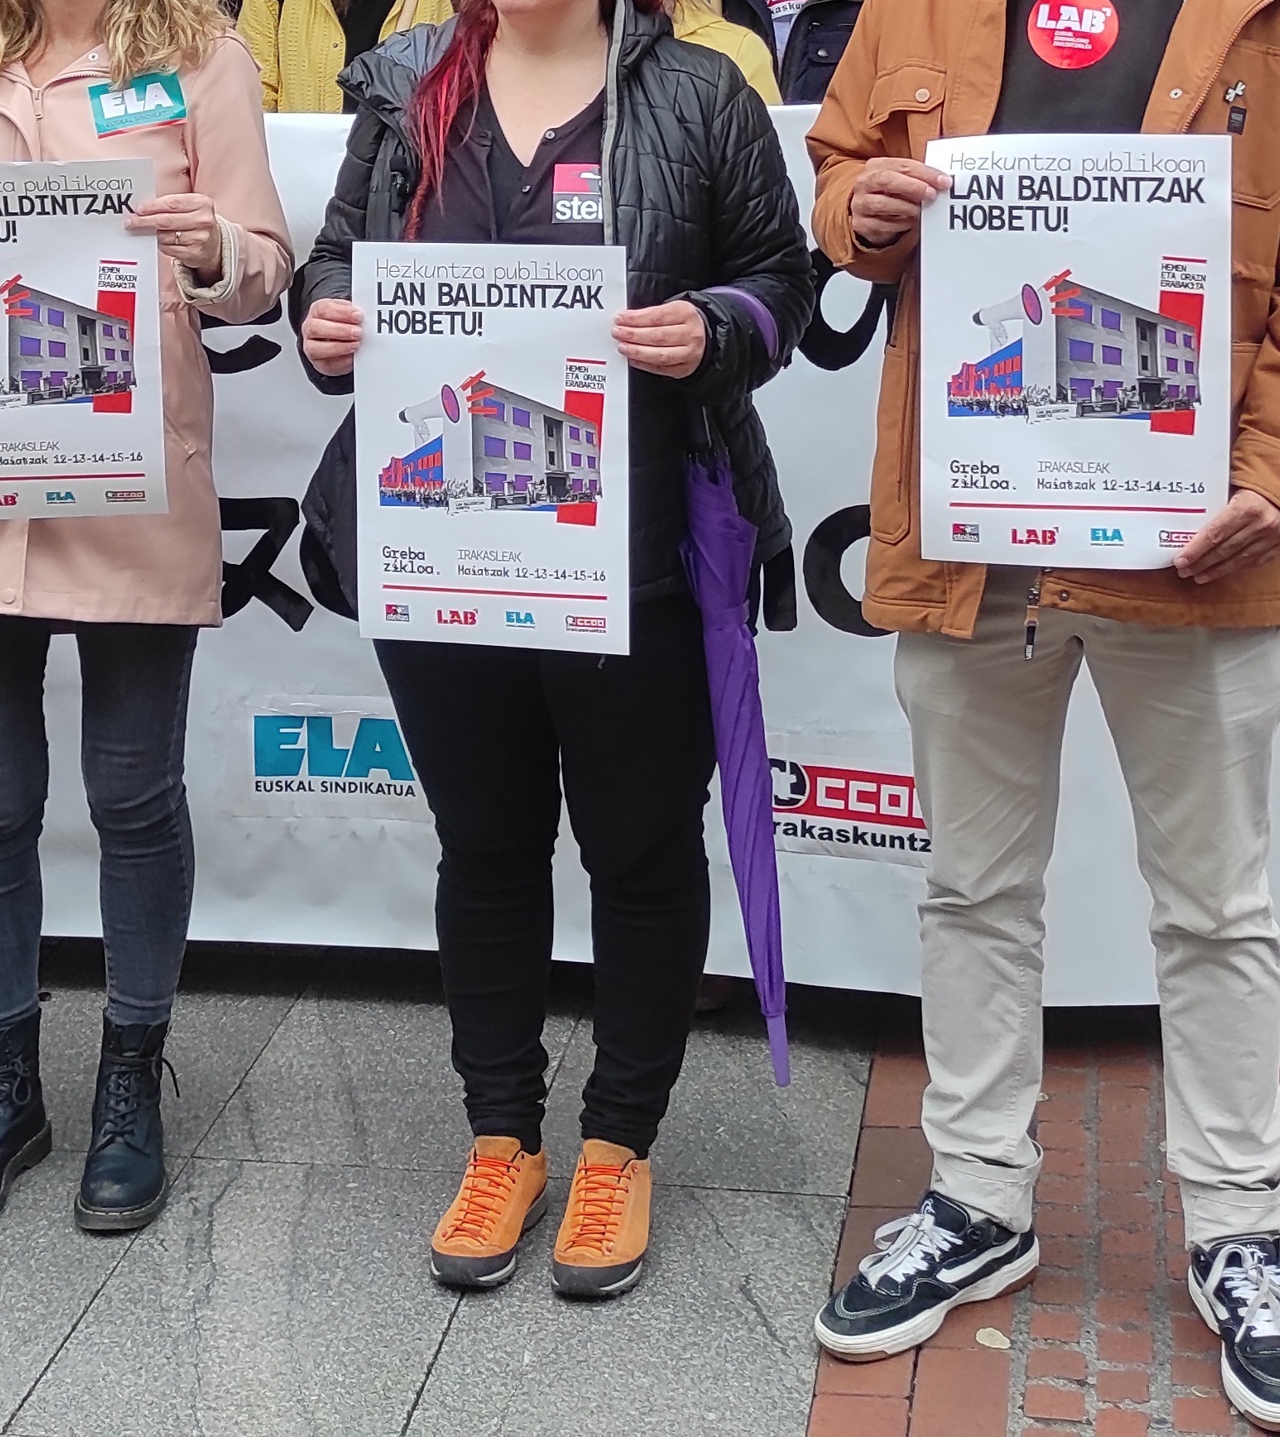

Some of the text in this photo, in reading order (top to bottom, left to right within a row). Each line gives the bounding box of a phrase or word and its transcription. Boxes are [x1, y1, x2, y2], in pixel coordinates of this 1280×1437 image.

[1037, 4, 1111, 33] LAB
[100, 82, 174, 119] ELA
[950, 151, 1206, 176] Hezkuntza publikoan
[24, 174, 133, 197] publikoan
[950, 174, 1206, 204] LAN BALDINTZAK
[949, 205, 1069, 232] HOBETU!
[376, 258, 603, 284] Hezkuntza publikoan
[377, 282, 604, 310] LAN BALDINTZAK
[377, 310, 483, 337] HOBETU!
[54, 452, 144, 465] 12-13-14-15-16
[950, 460, 1000, 475] Greba
[1037, 461, 1110, 474] IRAKASLEAK
[46, 491, 76, 503] ELA
[1103, 480, 1205, 494] 12-13-14-15-16
[1011, 527, 1059, 546] LAB
[1090, 528, 1124, 542] ELA
[382, 546, 425, 561] Greba
[457, 549, 522, 563] IRAKASLEAK
[515, 568, 606, 581] 12-13-14-15-16
[437, 609, 478, 625] LAB
[506, 611, 535, 624] ELA
[254, 716, 415, 781] ELA
[255, 780, 416, 798] EUSKAL SINDIKATUA
[773, 819, 932, 853] rakaskuntz
